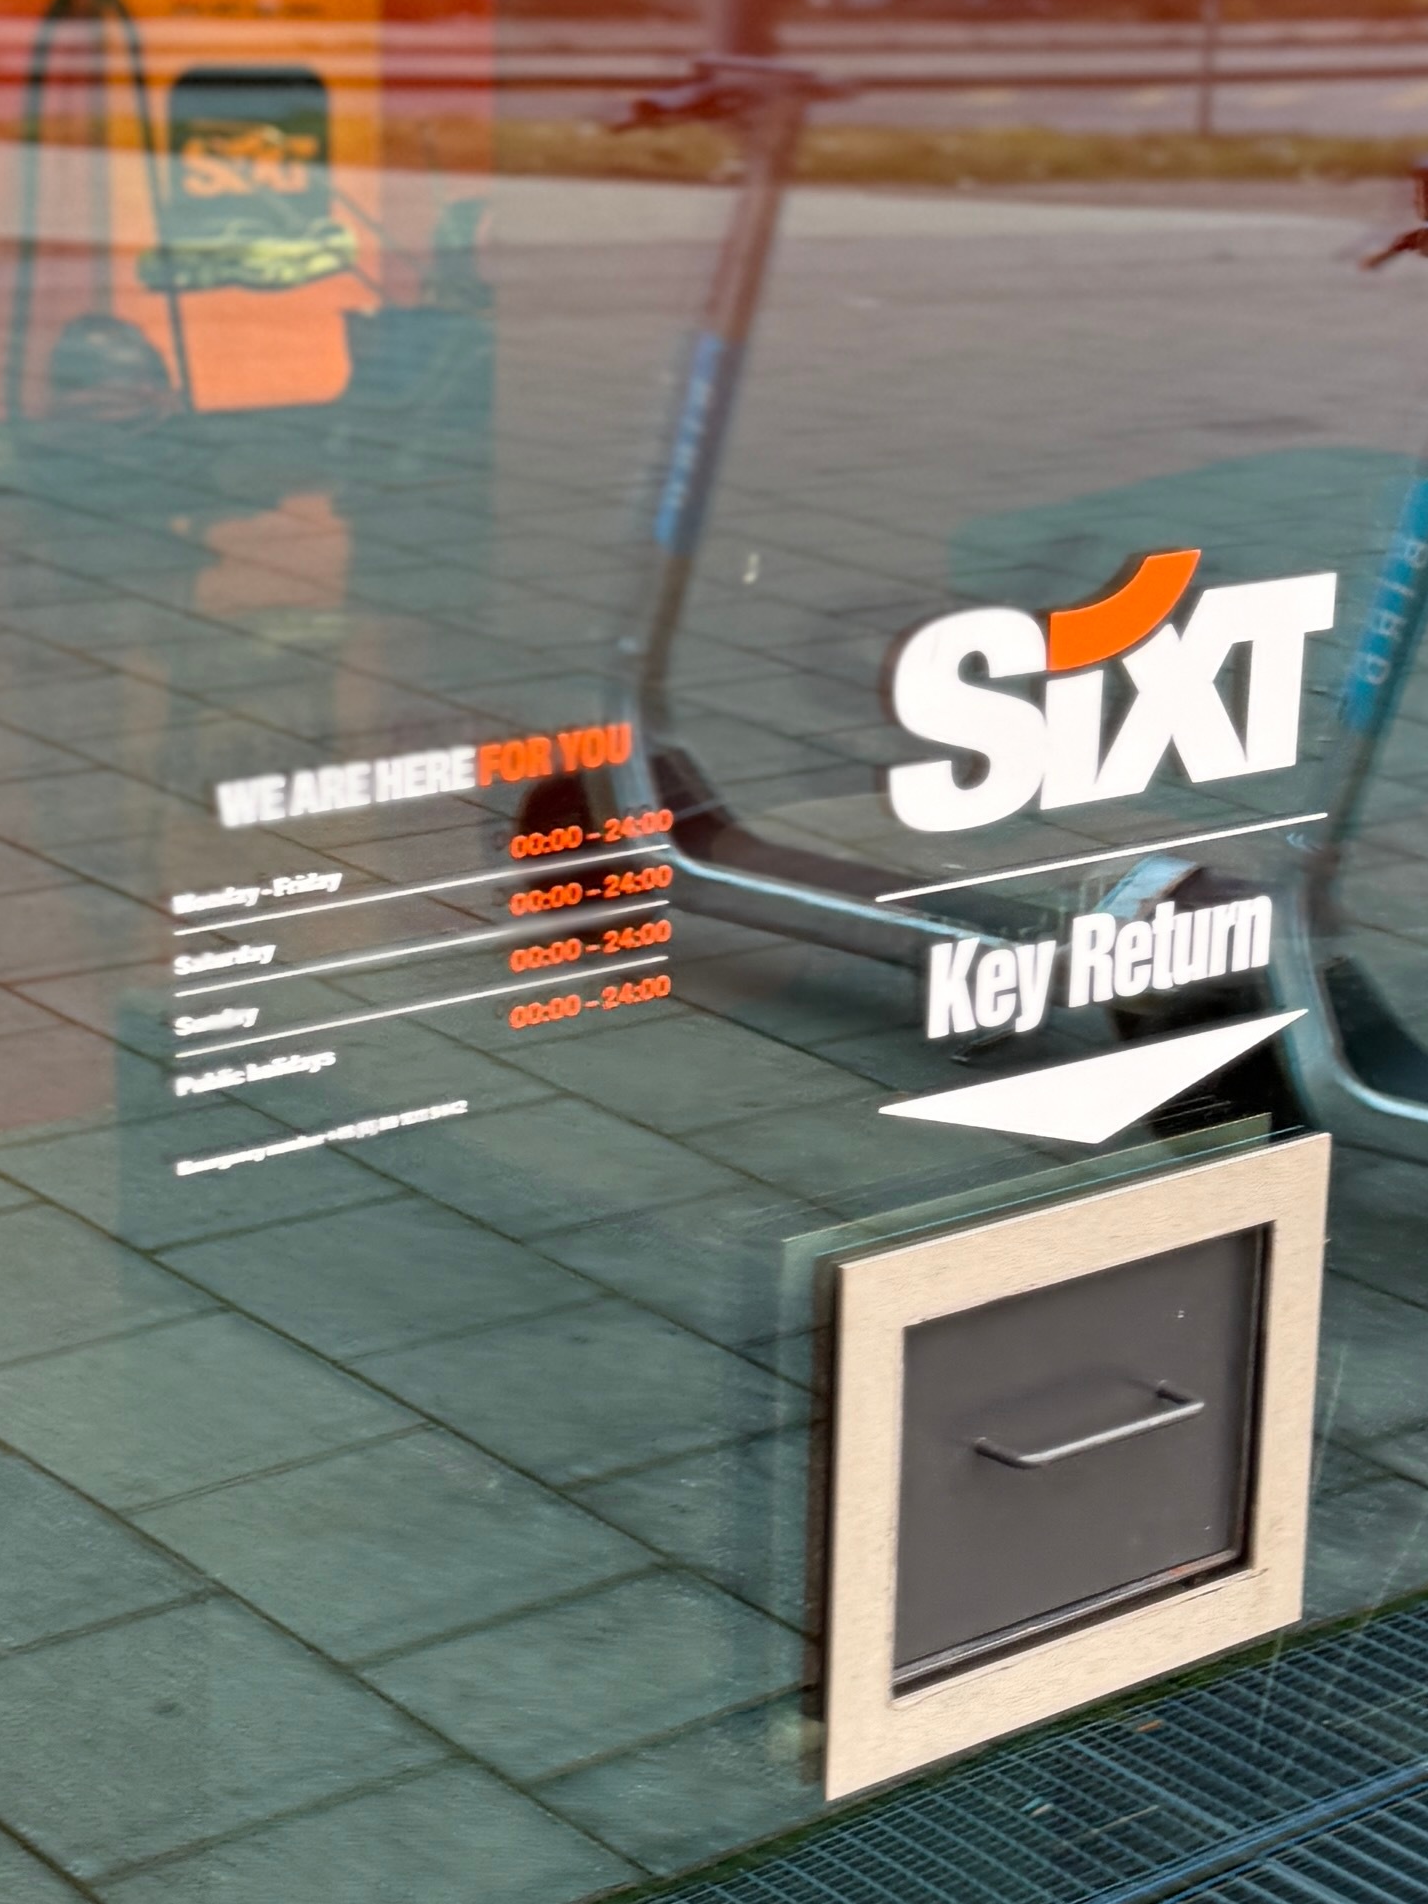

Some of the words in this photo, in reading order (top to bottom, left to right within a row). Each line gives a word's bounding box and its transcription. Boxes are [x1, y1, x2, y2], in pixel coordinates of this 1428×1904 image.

[217, 773, 286, 828] WE
[288, 762, 371, 817] ARE
[374, 746, 476, 803] HERE
[477, 736, 553, 786] FOR
[557, 722, 632, 771] YOU
[510, 825, 583, 859] 00:00
[604, 810, 673, 844] 24:00
[509, 882, 583, 916] 00:00
[604, 866, 672, 898] 24:00
[509, 938, 582, 973] 00:00
[603, 920, 671, 953] 24:00
[926, 937, 1057, 1039] Key
[1068, 895, 1273, 1009] Return
[509, 996, 581, 1029] 00:00
[601, 975, 671, 1010] 24:00
